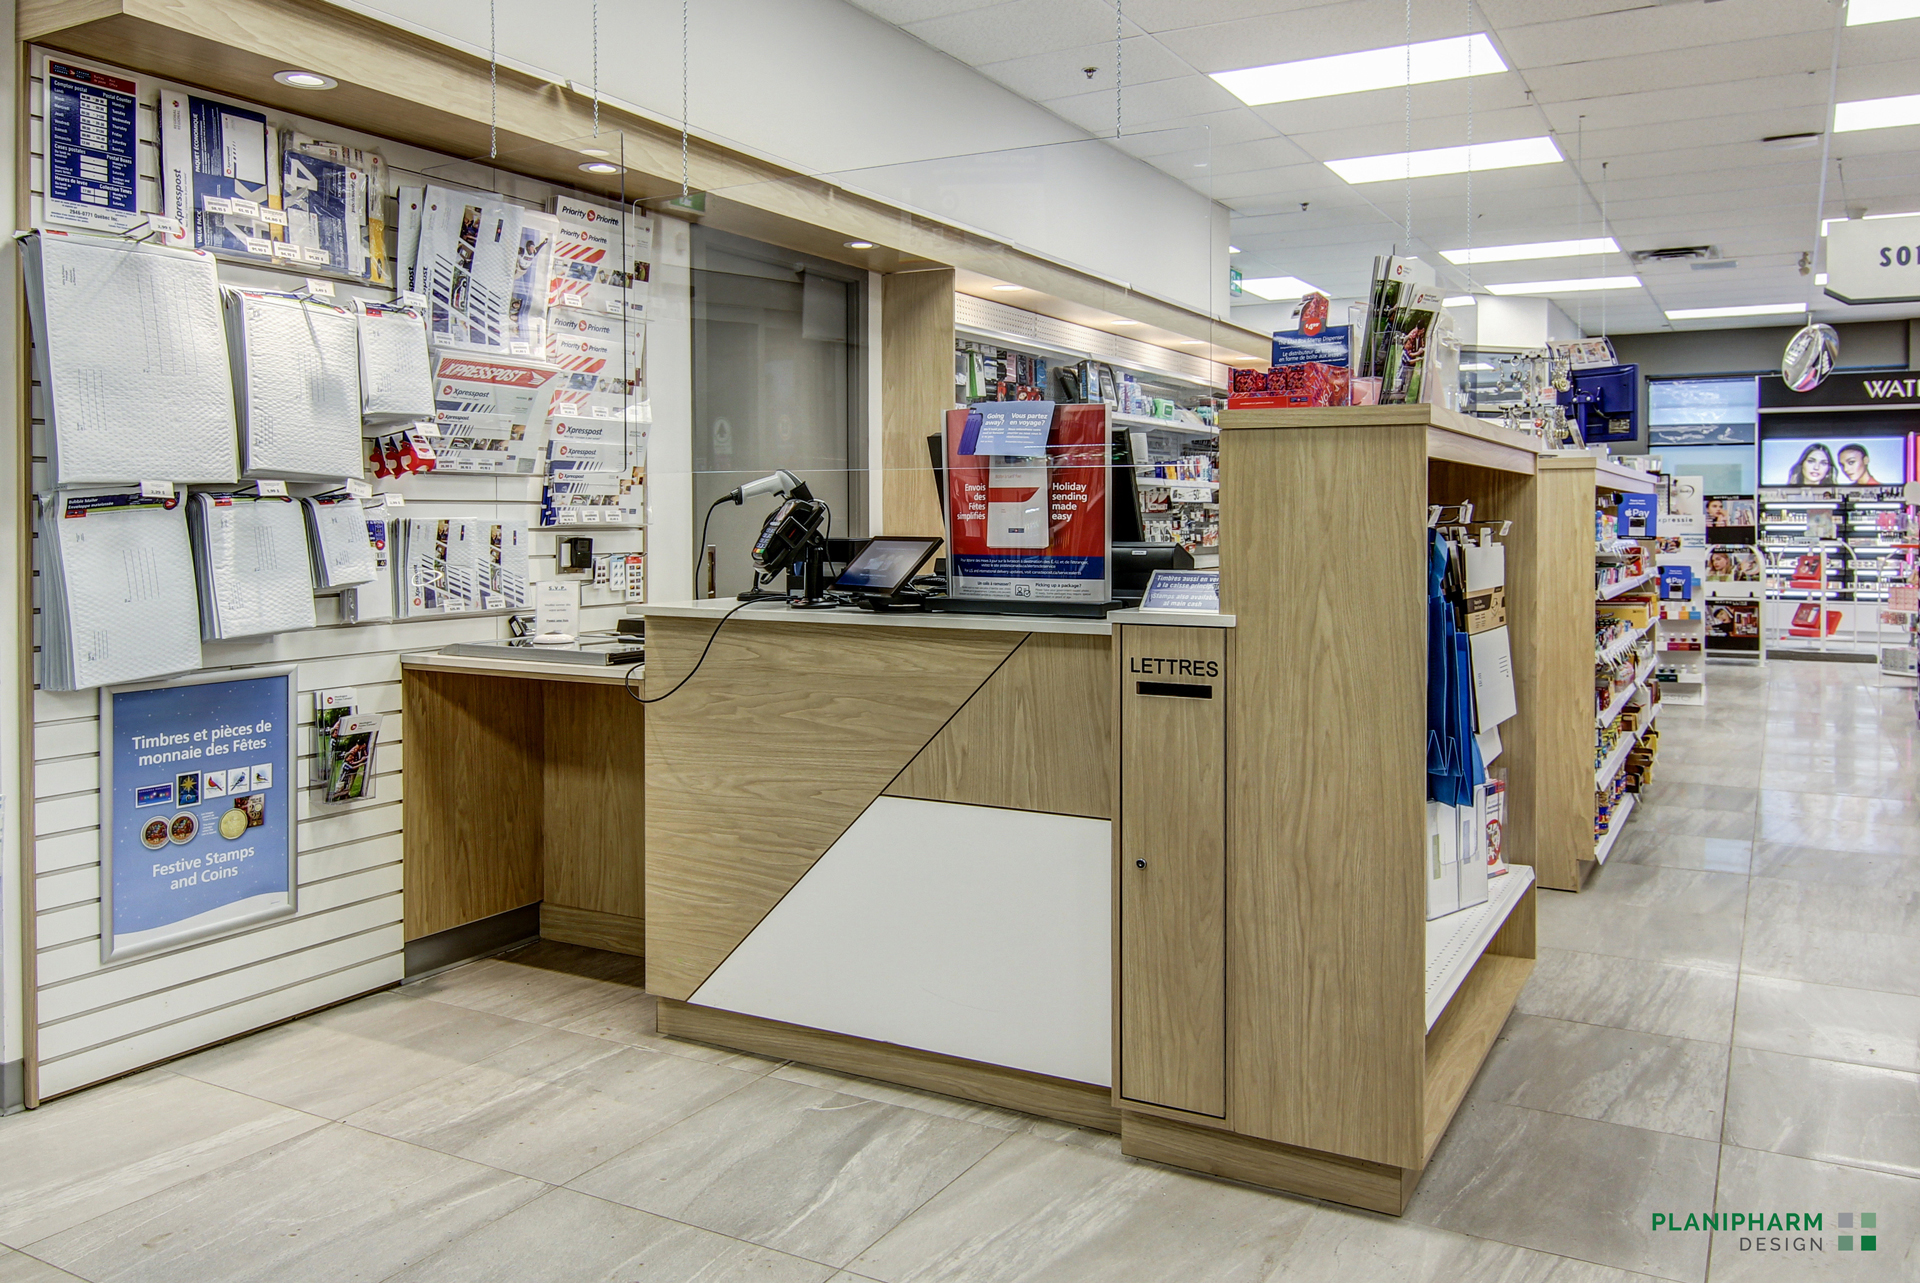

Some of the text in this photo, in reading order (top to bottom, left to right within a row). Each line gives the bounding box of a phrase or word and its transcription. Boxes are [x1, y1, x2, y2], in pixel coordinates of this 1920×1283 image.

[54, 80, 73, 89] Comptoir
[562, 206, 619, 226] Priority Priorité
[560, 229, 607, 244] Priority Priorité
[554, 318, 610, 333] Priority Priorité
[561, 341, 580, 350] Priority
[441, 363, 527, 382] XPRESSPOST
[453, 388, 490, 398] Xpresspost
[566, 426, 602, 436] Xpresspost
[964, 484, 986, 492] Envois
[1052, 483, 1087, 492] Holiday
[1052, 492, 1087, 502] sending
[1052, 502, 1077, 510] made
[957, 512, 986, 521] simplifiés
[1052, 513, 1072, 522] easy
[1633, 509, 1650, 517] Pay
[1131, 657, 1218, 677] LETTRES
[132, 720, 272, 750] Timbres et pièces de
[138, 737, 267, 767] monnaie des Fêtes
[152, 846, 255, 878] Festive Stamps
[170, 865, 238, 890] and Coins
